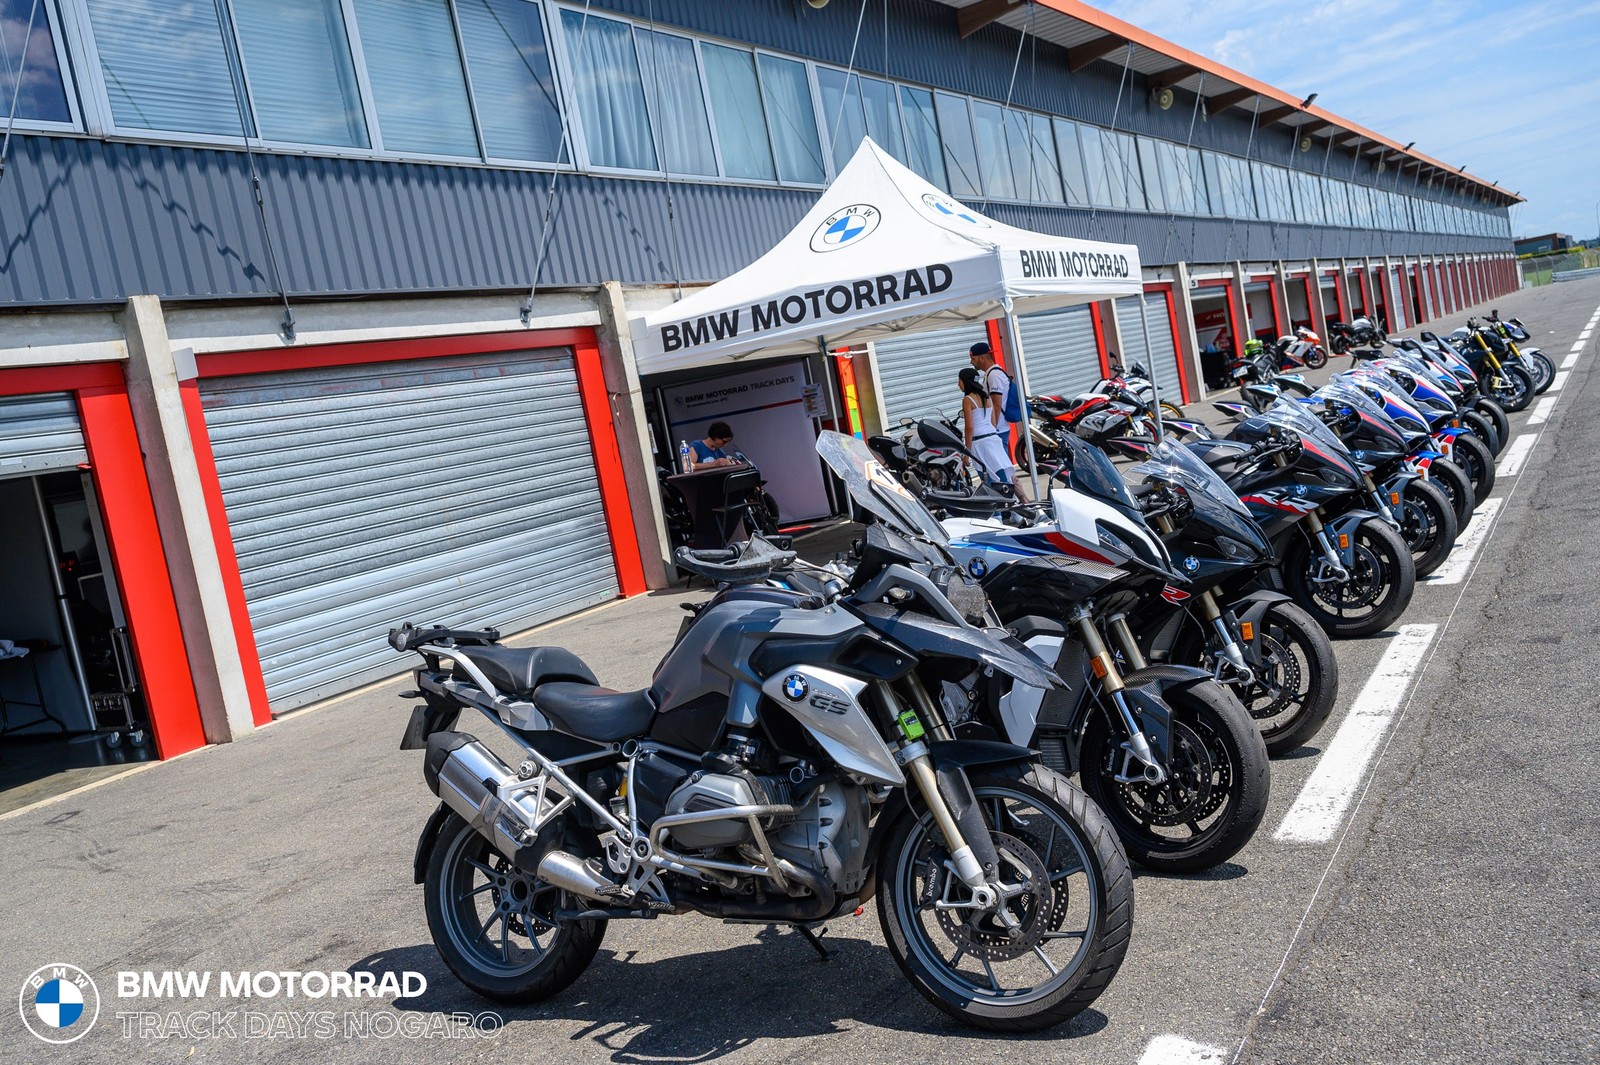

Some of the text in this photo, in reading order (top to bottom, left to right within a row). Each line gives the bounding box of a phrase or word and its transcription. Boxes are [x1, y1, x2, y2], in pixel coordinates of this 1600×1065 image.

[825, 206, 876, 226] BMW
[1019, 249, 1129, 278] BMW MOTORRAD
[660, 263, 954, 353] BMW MOTORRAD
[685, 393, 704, 403] BMW
[705, 385, 748, 400] MOTORRAD
[750, 380, 775, 391] TRACK
[775, 375, 795, 386] DAYS
[809, 695, 852, 715] GS
[925, 868, 938, 897] brembo
